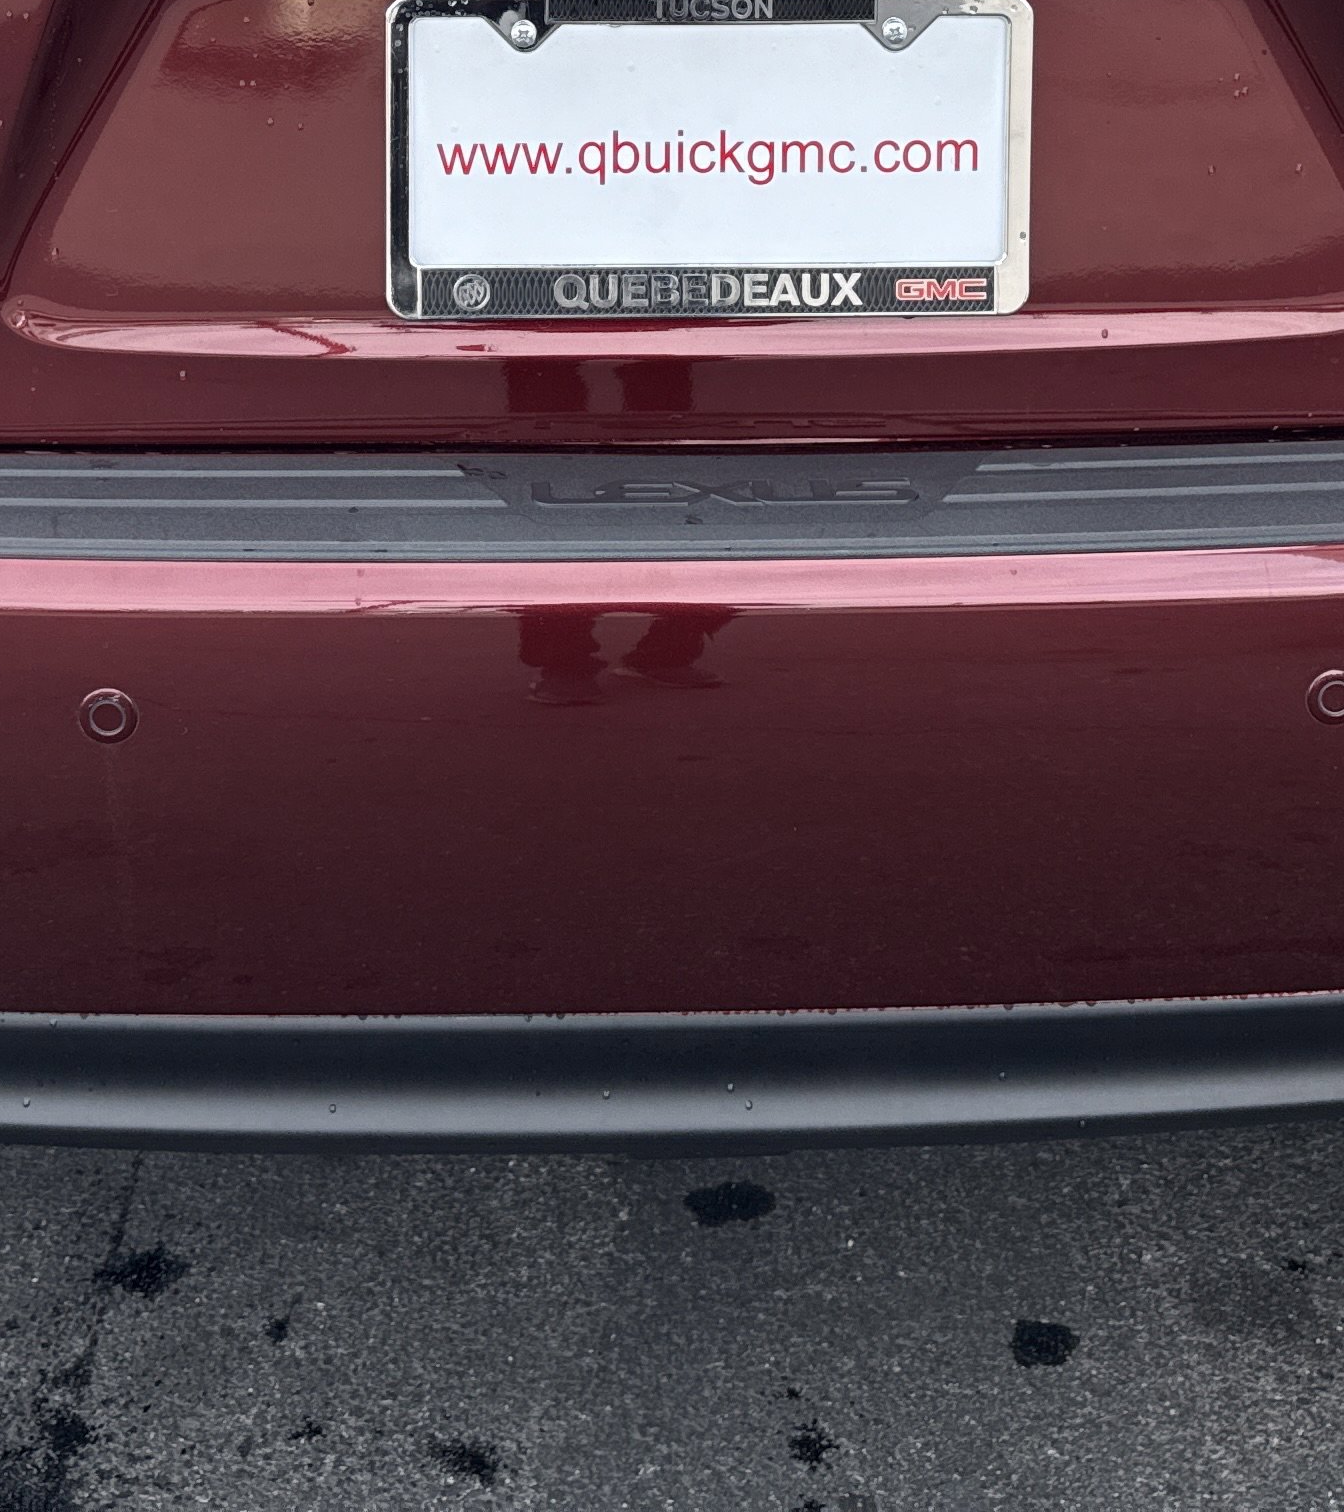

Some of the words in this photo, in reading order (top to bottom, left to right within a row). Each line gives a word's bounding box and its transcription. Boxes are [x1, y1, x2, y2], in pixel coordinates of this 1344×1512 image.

[436, 129, 979, 185] www.qbuickgmc.com
[554, 272, 863, 309] QUEBEDEAUX
[895, 278, 988, 301] GMC
[531, 477, 920, 506] LEXUS
